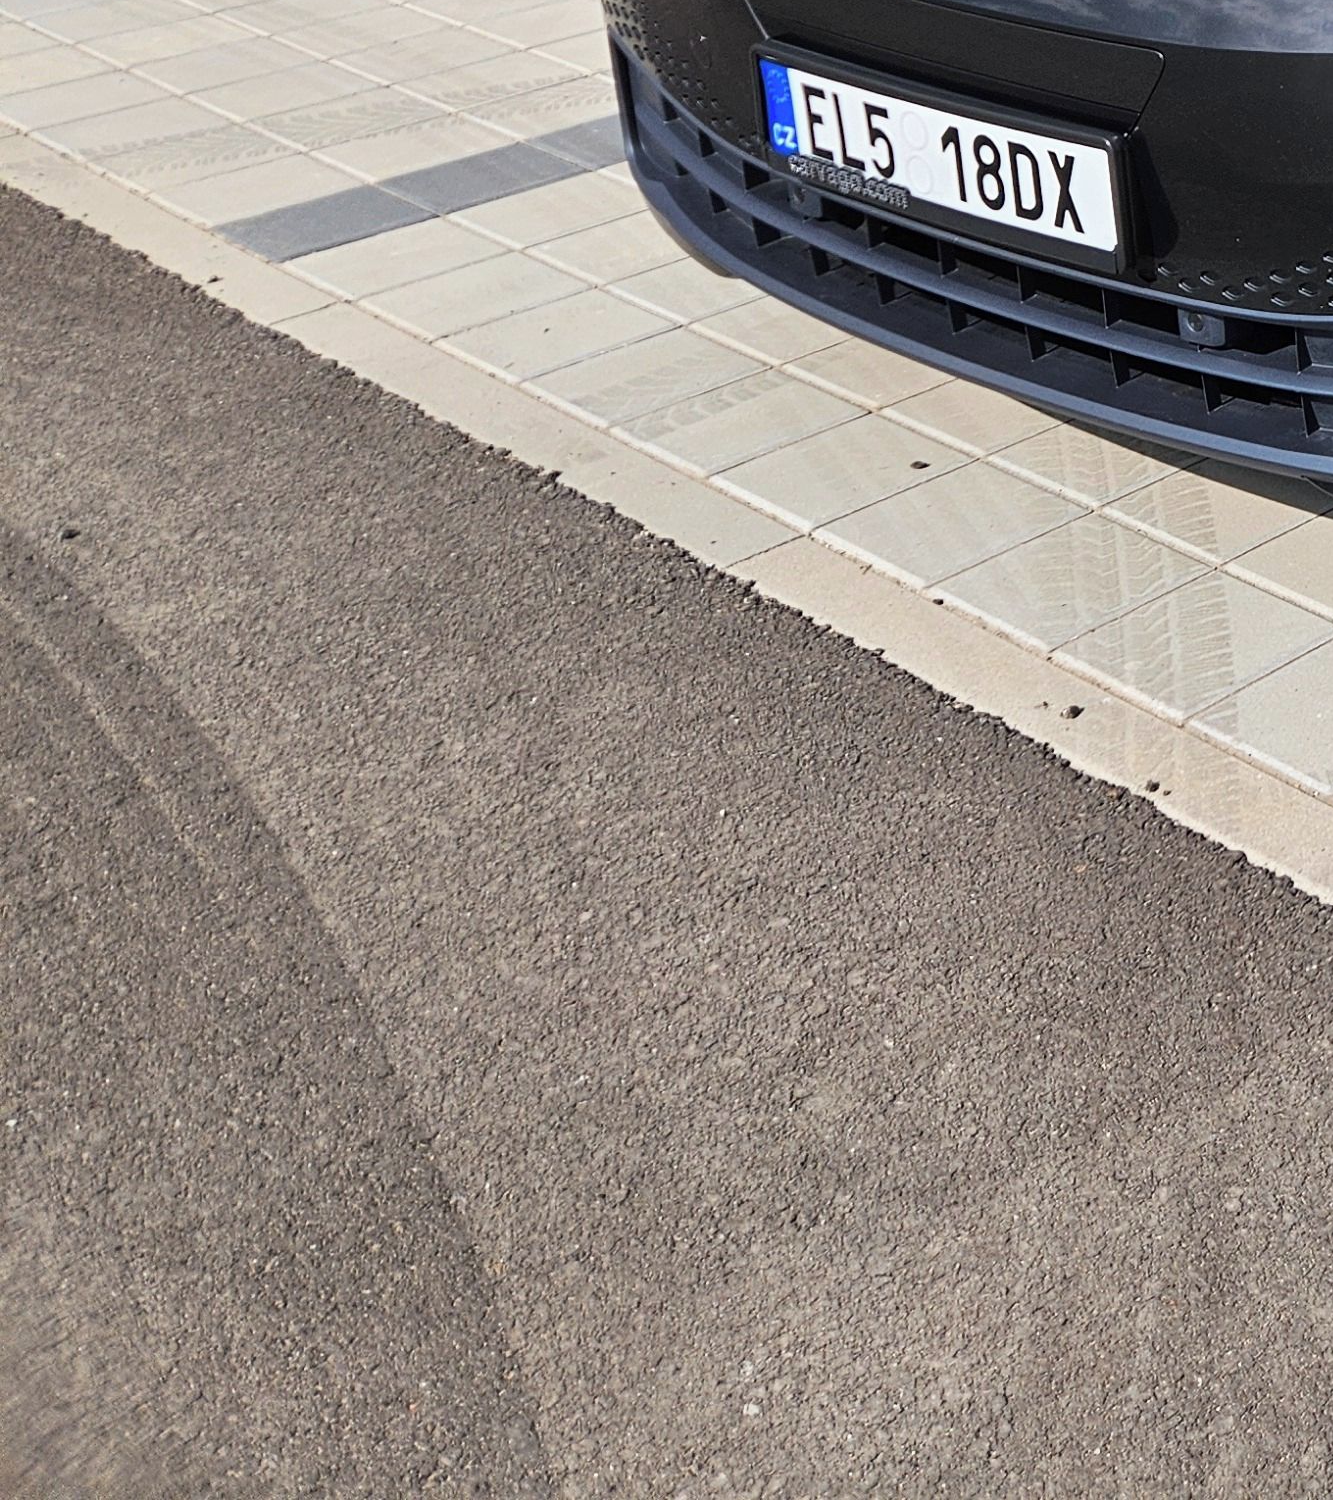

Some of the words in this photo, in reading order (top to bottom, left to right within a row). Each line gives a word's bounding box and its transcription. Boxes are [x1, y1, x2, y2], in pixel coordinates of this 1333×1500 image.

[772, 121, 798, 149] CZ
[801, 83, 896, 179] EL5
[940, 125, 1086, 234] 18DX
